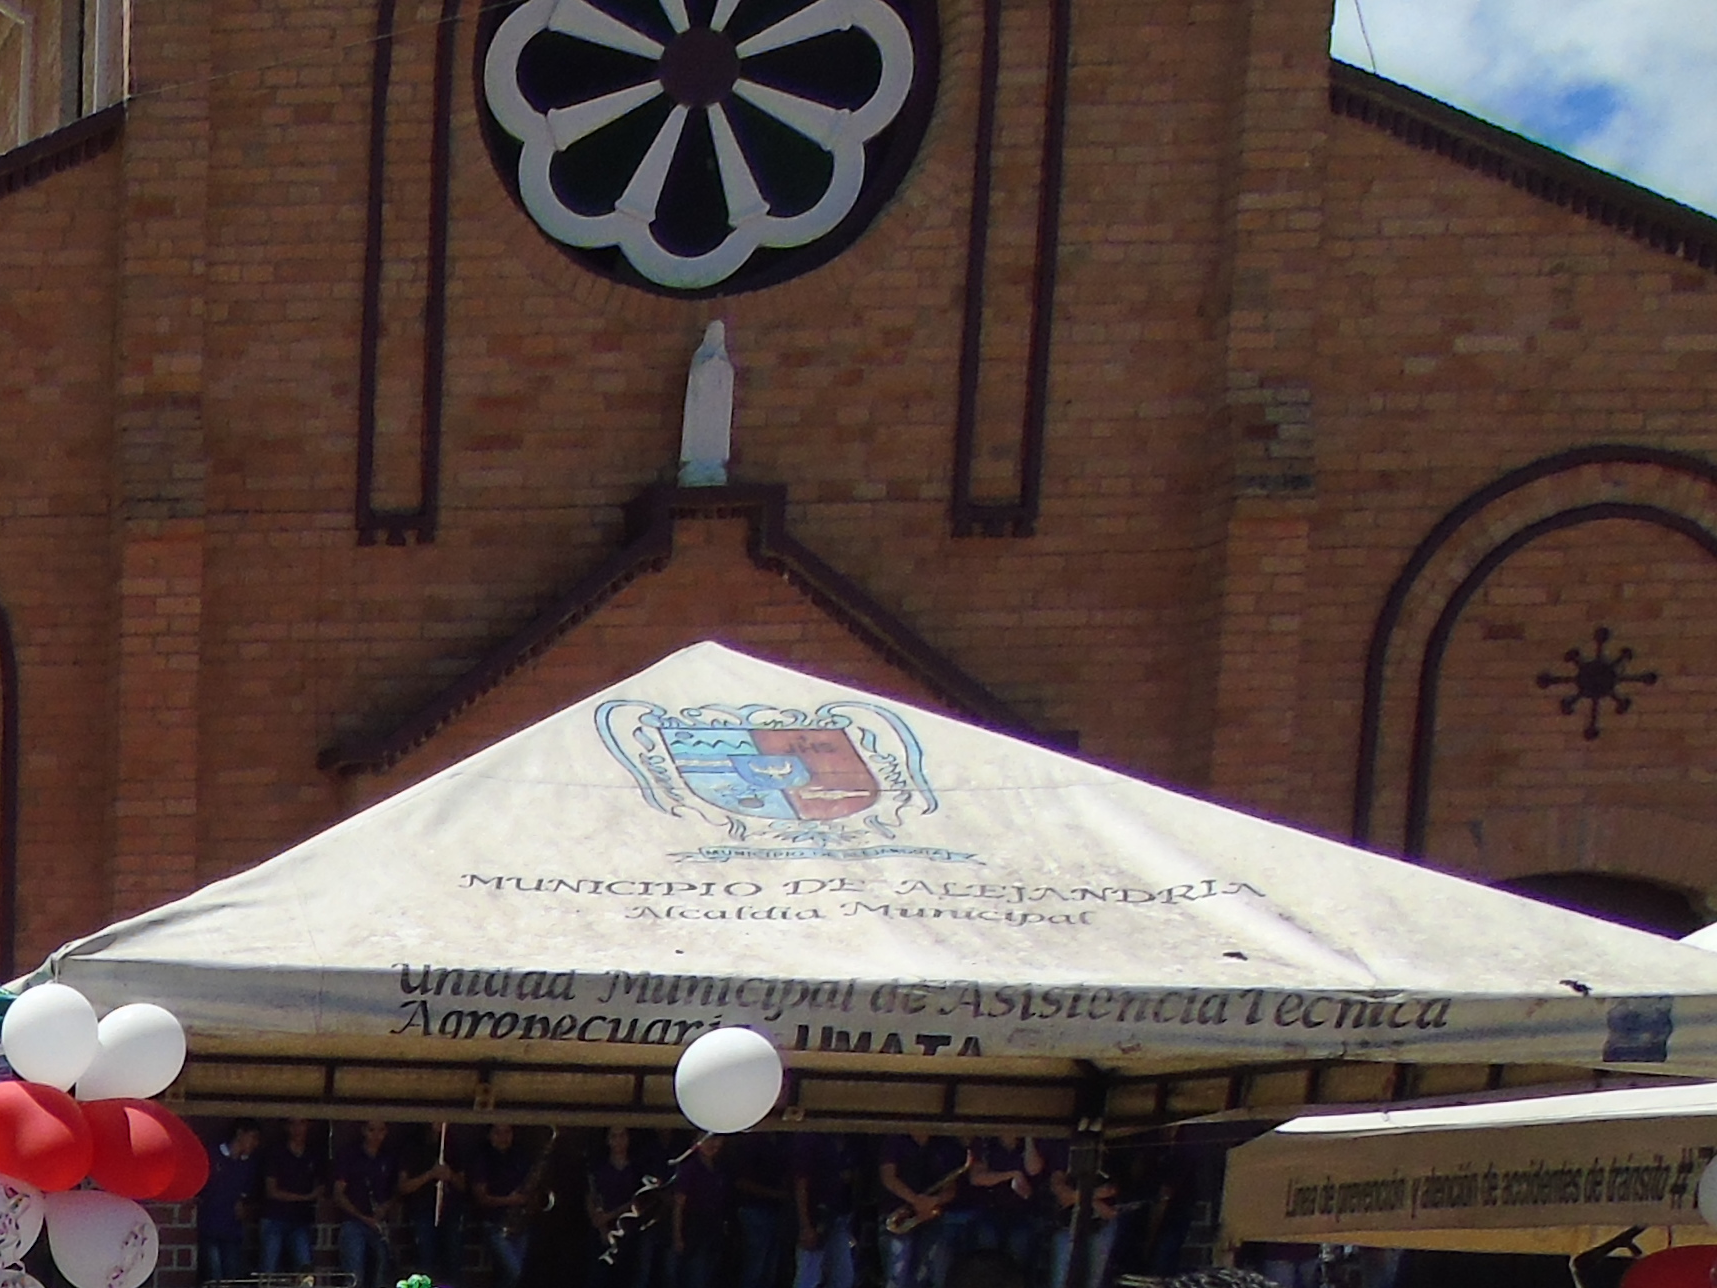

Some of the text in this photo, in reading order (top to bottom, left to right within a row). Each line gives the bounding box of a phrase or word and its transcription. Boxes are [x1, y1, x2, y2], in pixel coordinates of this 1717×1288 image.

[459, 873, 763, 897] MUNICIPIO
[782, 877, 865, 897] DE
[839, 901, 1097, 926] Municipal
